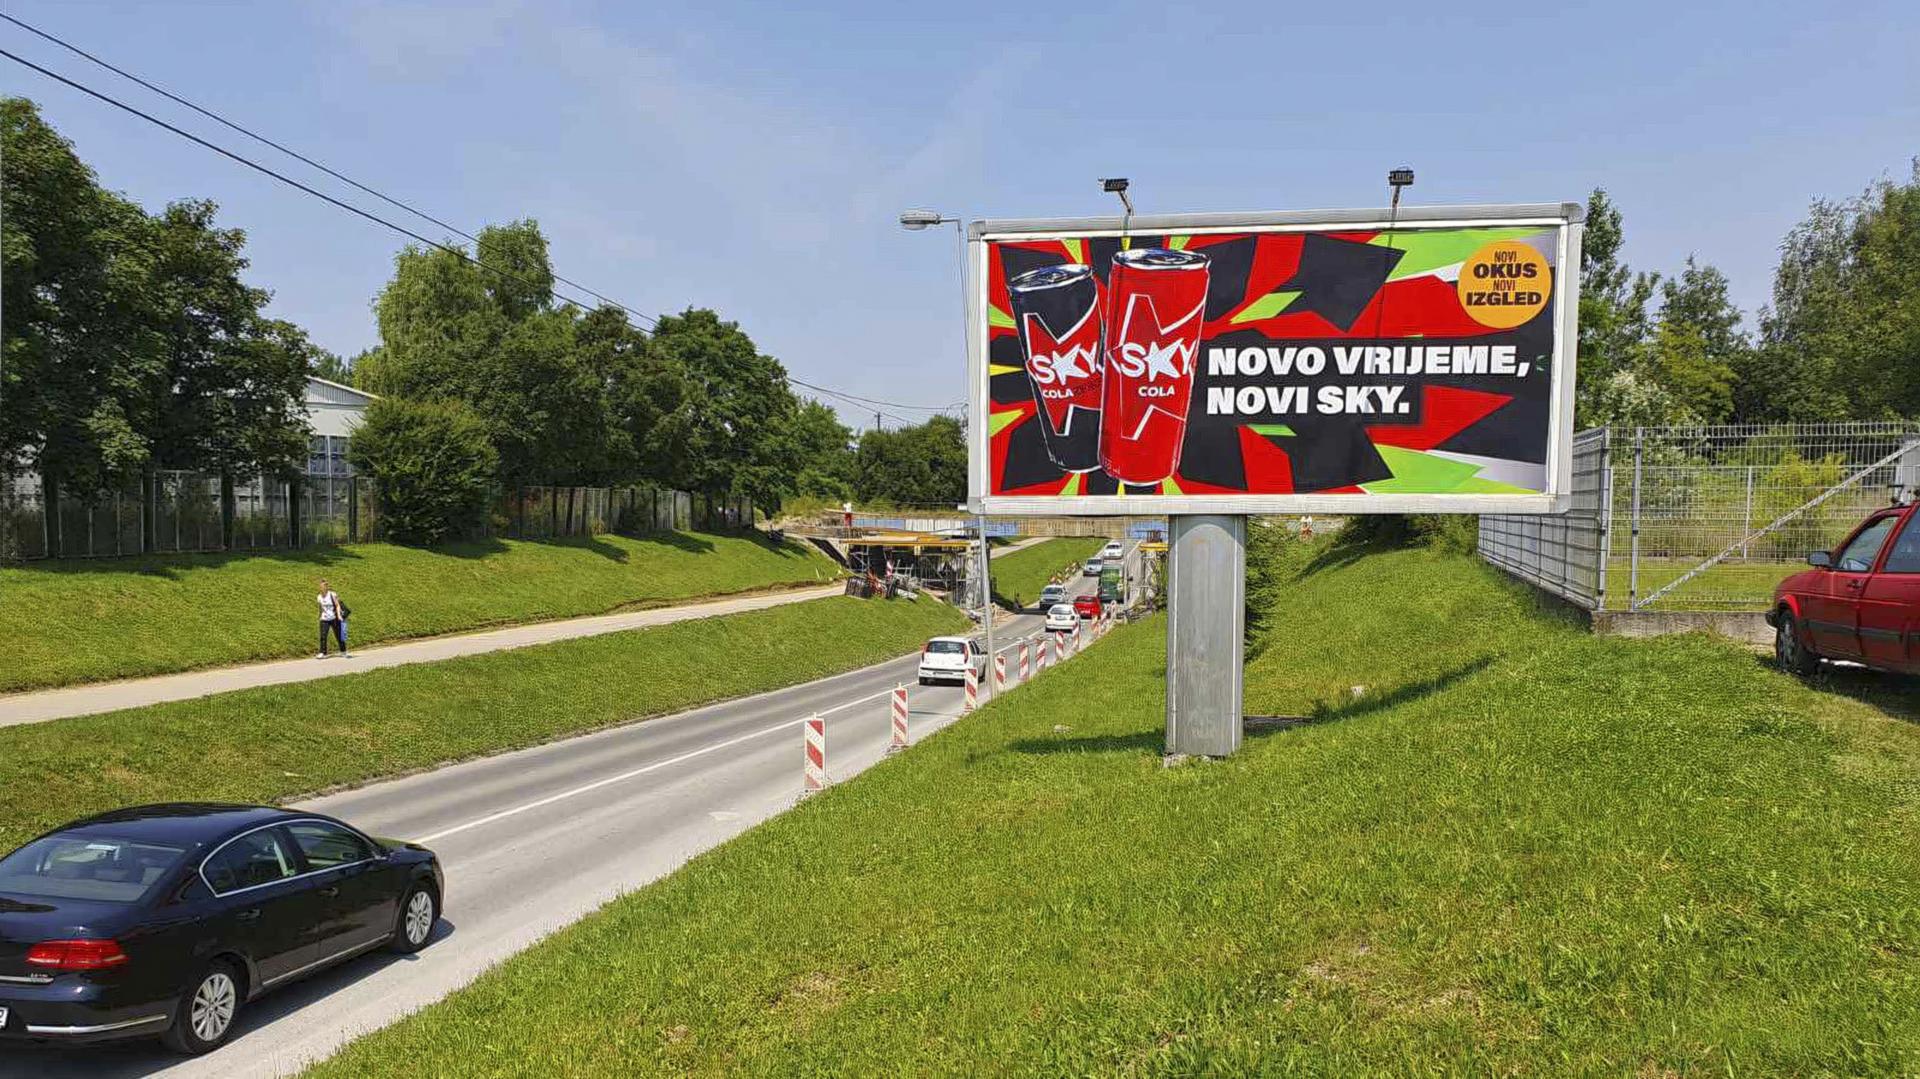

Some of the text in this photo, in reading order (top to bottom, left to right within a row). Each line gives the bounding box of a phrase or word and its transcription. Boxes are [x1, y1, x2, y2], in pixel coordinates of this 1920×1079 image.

[1494, 250, 1517, 262] NOVI
[1473, 263, 1538, 279] OKUS
[1492, 279, 1516, 291] NOVI
[1466, 291, 1542, 306] IZGLED
[1031, 340, 1098, 386] SKY
[1120, 337, 1198, 382] SKY
[1208, 345, 1531, 377] NOVO VRIJEME,
[1042, 388, 1073, 399] COLA
[1137, 385, 1175, 397] COLA
[1207, 385, 1410, 415] NOVI SKY.
